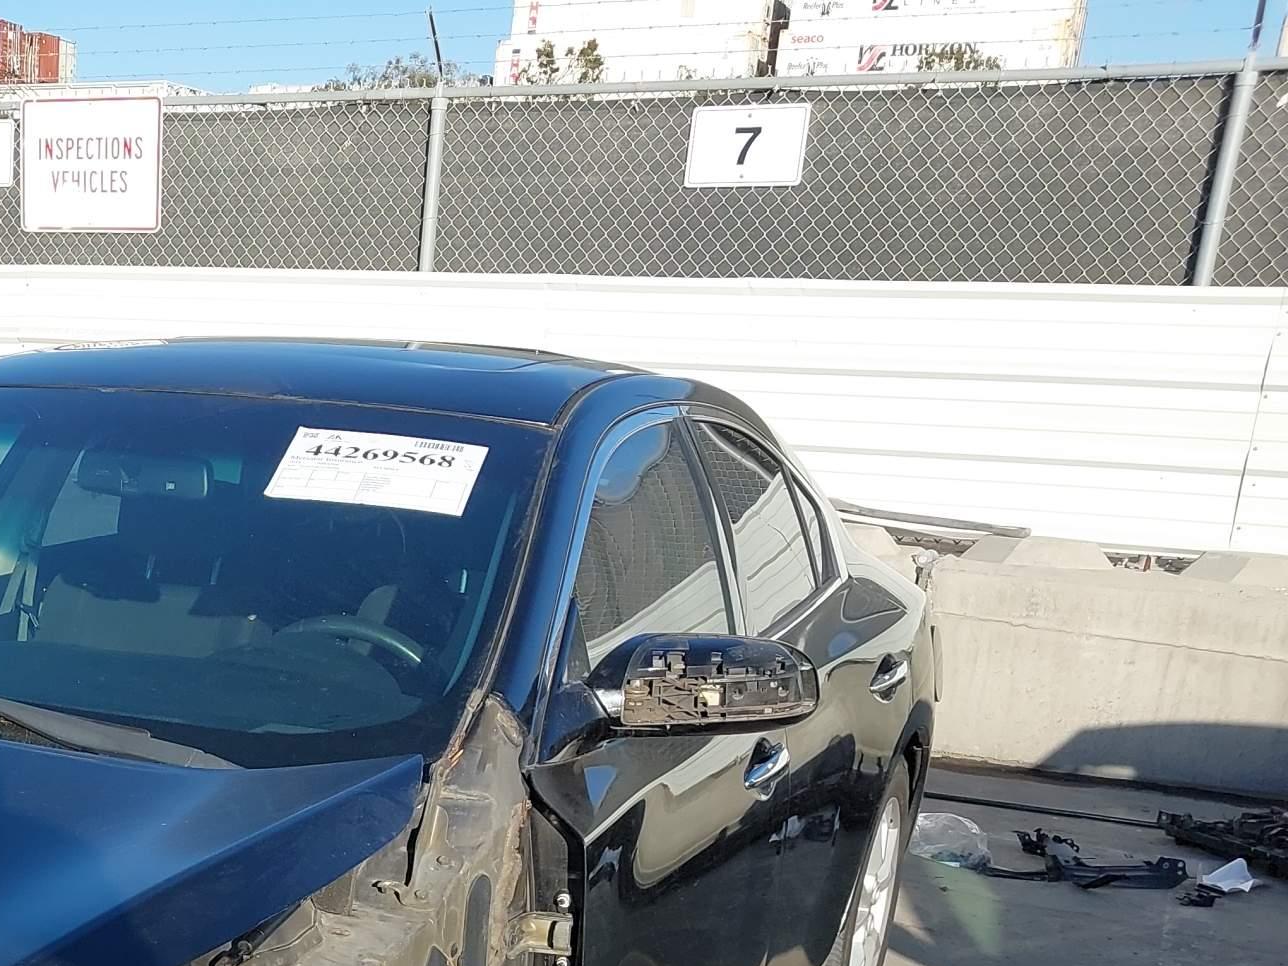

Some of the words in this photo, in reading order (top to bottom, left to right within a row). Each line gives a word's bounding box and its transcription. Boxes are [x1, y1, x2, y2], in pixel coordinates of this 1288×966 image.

[791, 34, 824, 44] seaco
[38, 136, 144, 161] INSPECTIONS
[734, 126, 763, 166] 7
[305, 444, 456, 468] 44269568
